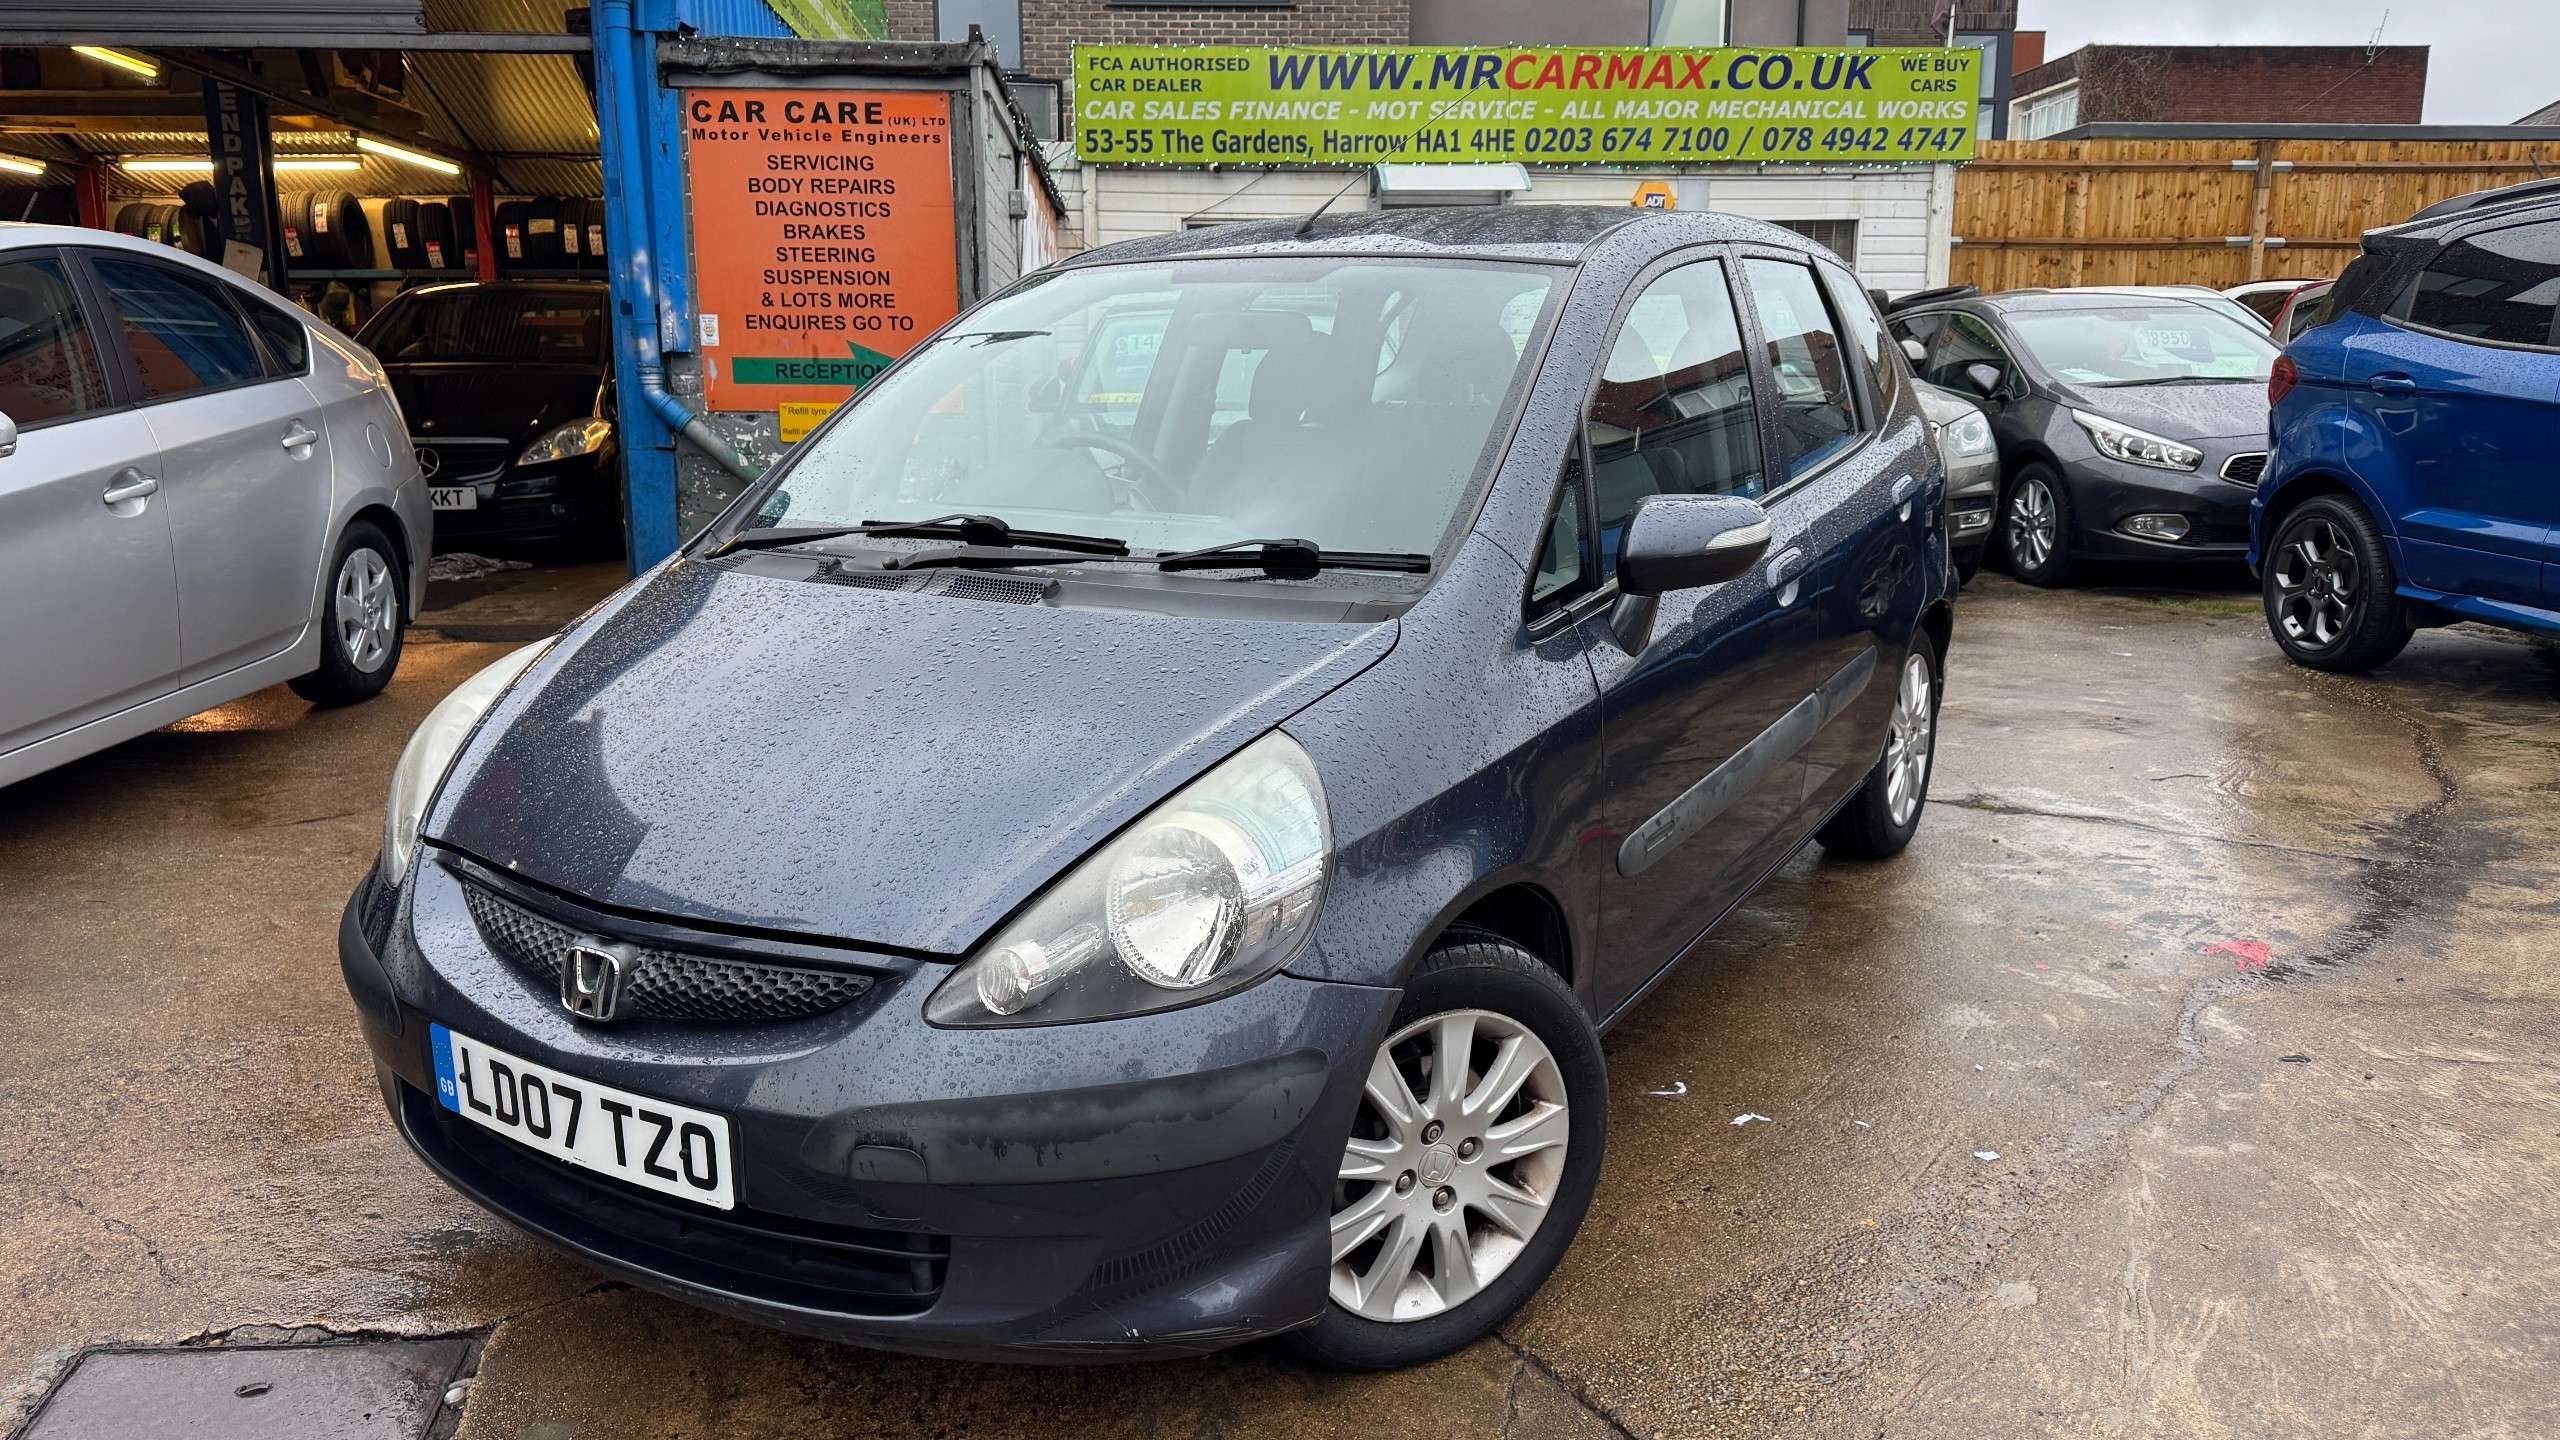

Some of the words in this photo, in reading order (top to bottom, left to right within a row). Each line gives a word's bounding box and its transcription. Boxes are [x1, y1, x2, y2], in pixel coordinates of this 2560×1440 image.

[1089, 57, 1124, 71] FCA
[1129, 57, 1250, 71] AUTHORISED
[1269, 54, 1879, 90] WWW.MRCARMAX.CO.UK
[1901, 59, 1928, 72] WE
[1934, 59, 1970, 72] BUY
[1090, 78, 1126, 92] CAR
[1133, 78, 1203, 92] DEALER
[1911, 79, 1957, 92] CARS
[691, 100, 766, 123] CAR
[784, 101, 884, 125] CARE
[888, 116, 917, 127] (UK)
[922, 116, 946, 126] LTD
[1085, 100, 1135, 120] CAR
[1143, 100, 1222, 120] SALES
[1229, 100, 1342, 120] FINANCE
[1367, 100, 1423, 120] MOT
[1428, 100, 1537, 120] SERVICE
[1561, 100, 1605, 119] ALL
[1614, 100, 1699, 119] MAJOR
[1706, 100, 1867, 119] MECHANICAL
[1877, 100, 1969, 119] WORKS
[692, 128, 749, 141] Motor
[758, 129, 832, 142] Vehicle
[842, 130, 942, 145] Engineers
[1085, 129, 1154, 153] 53-55
[1161, 128, 1204, 153] The
[1212, 128, 1314, 158] Gardens,
[1323, 129, 1408, 153] Harrow
[1416, 129, 1461, 153] HA1
[1470, 129, 1516, 152] 4HE
[1524, 127, 1594, 152] 0203
[1602, 127, 1653, 152] 674
[1662, 127, 1730, 152] 7100
[1762, 126, 1814, 152] 078
[1821, 126, 1889, 151] 4942
[1897, 126, 1967, 151] 4747
[767, 155, 875, 171] SERVICING
[748, 178, 804, 193] BODY
[811, 179, 895, 194] REPAIRS
[755, 201, 891, 217] DIAGNOSTICS
[1645, 196, 1666, 208] ADT
[784, 224, 865, 240] BRAKES
[776, 247, 875, 263] STEERING
[764, 269, 890, 285] SUSPENSION
[761, 292, 774, 307] &
[781, 292, 832, 308] LOTS
[838, 293, 896, 308] MORE
[745, 315, 846, 331] ENQUIRES
[853, 316, 882, 331] GO
[888, 316, 914, 331] TO
[440, 1077, 454, 1096] GB
[460, 1047, 583, 1149] LD07
